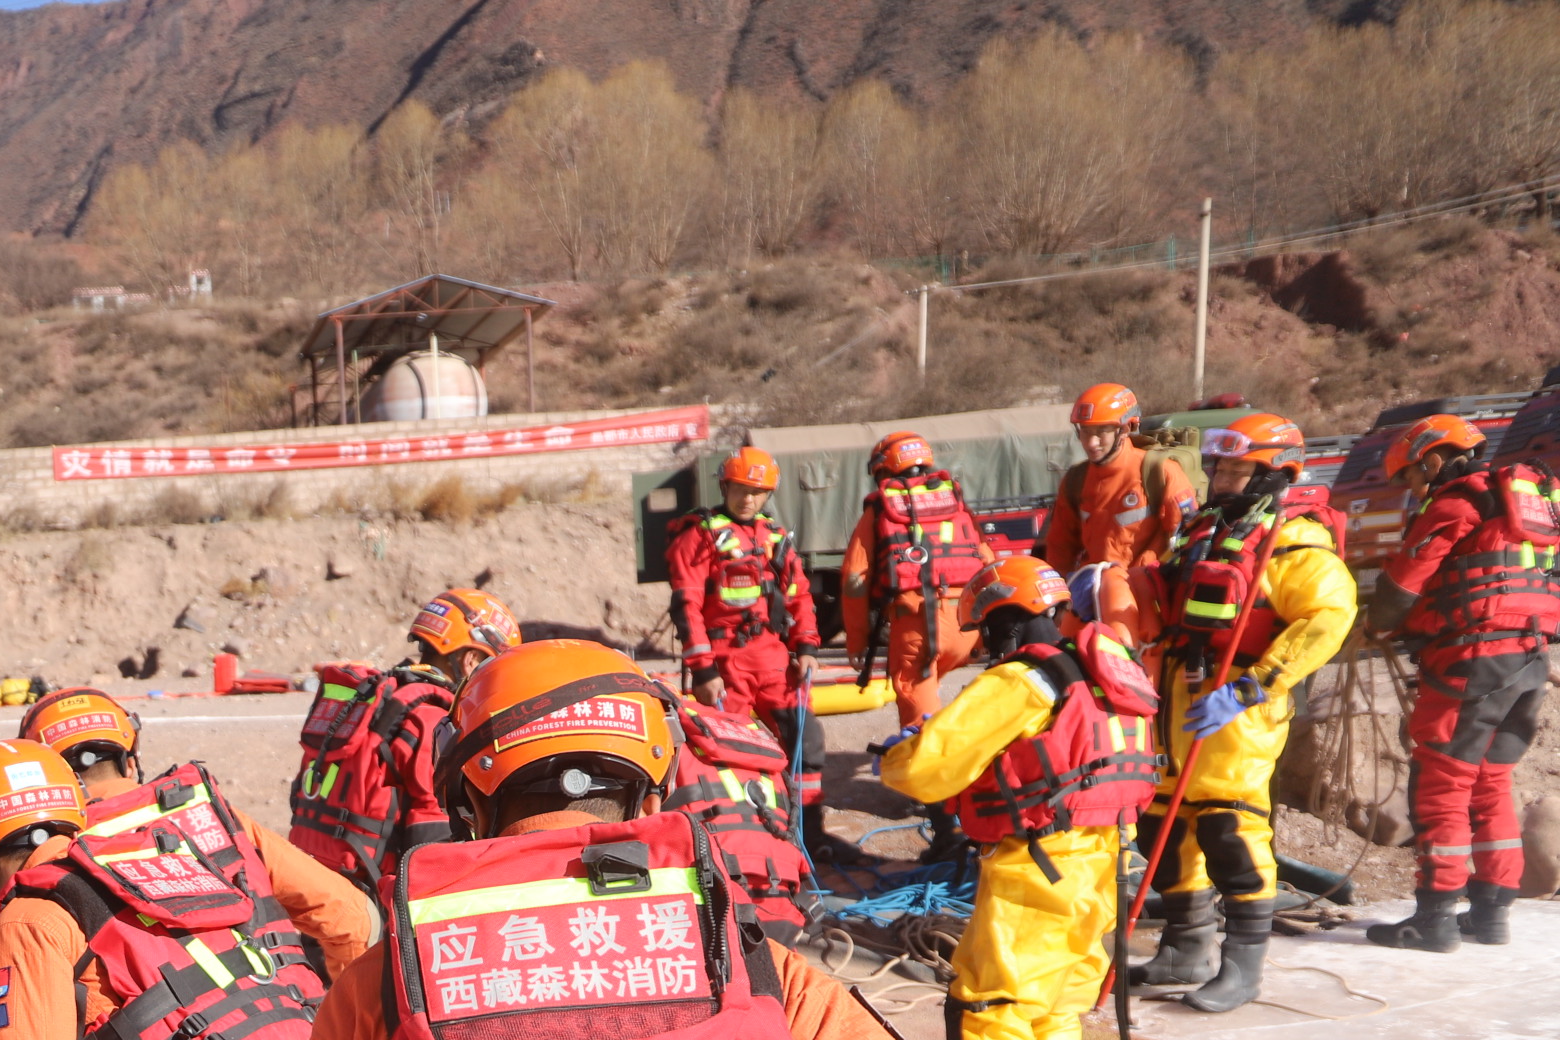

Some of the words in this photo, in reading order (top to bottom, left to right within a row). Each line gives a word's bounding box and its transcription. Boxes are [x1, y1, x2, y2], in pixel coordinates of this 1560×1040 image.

[47, 714, 112, 737] 中国森林消防
[506, 727, 531, 740] CHINA
[532, 721, 564, 732] FOREST
[566, 718, 585, 727] FIRE
[587, 719, 637, 731] PREVENTION
[430, 900, 696, 975] 应急救援
[435, 953, 697, 1014] 西藏森林消防
